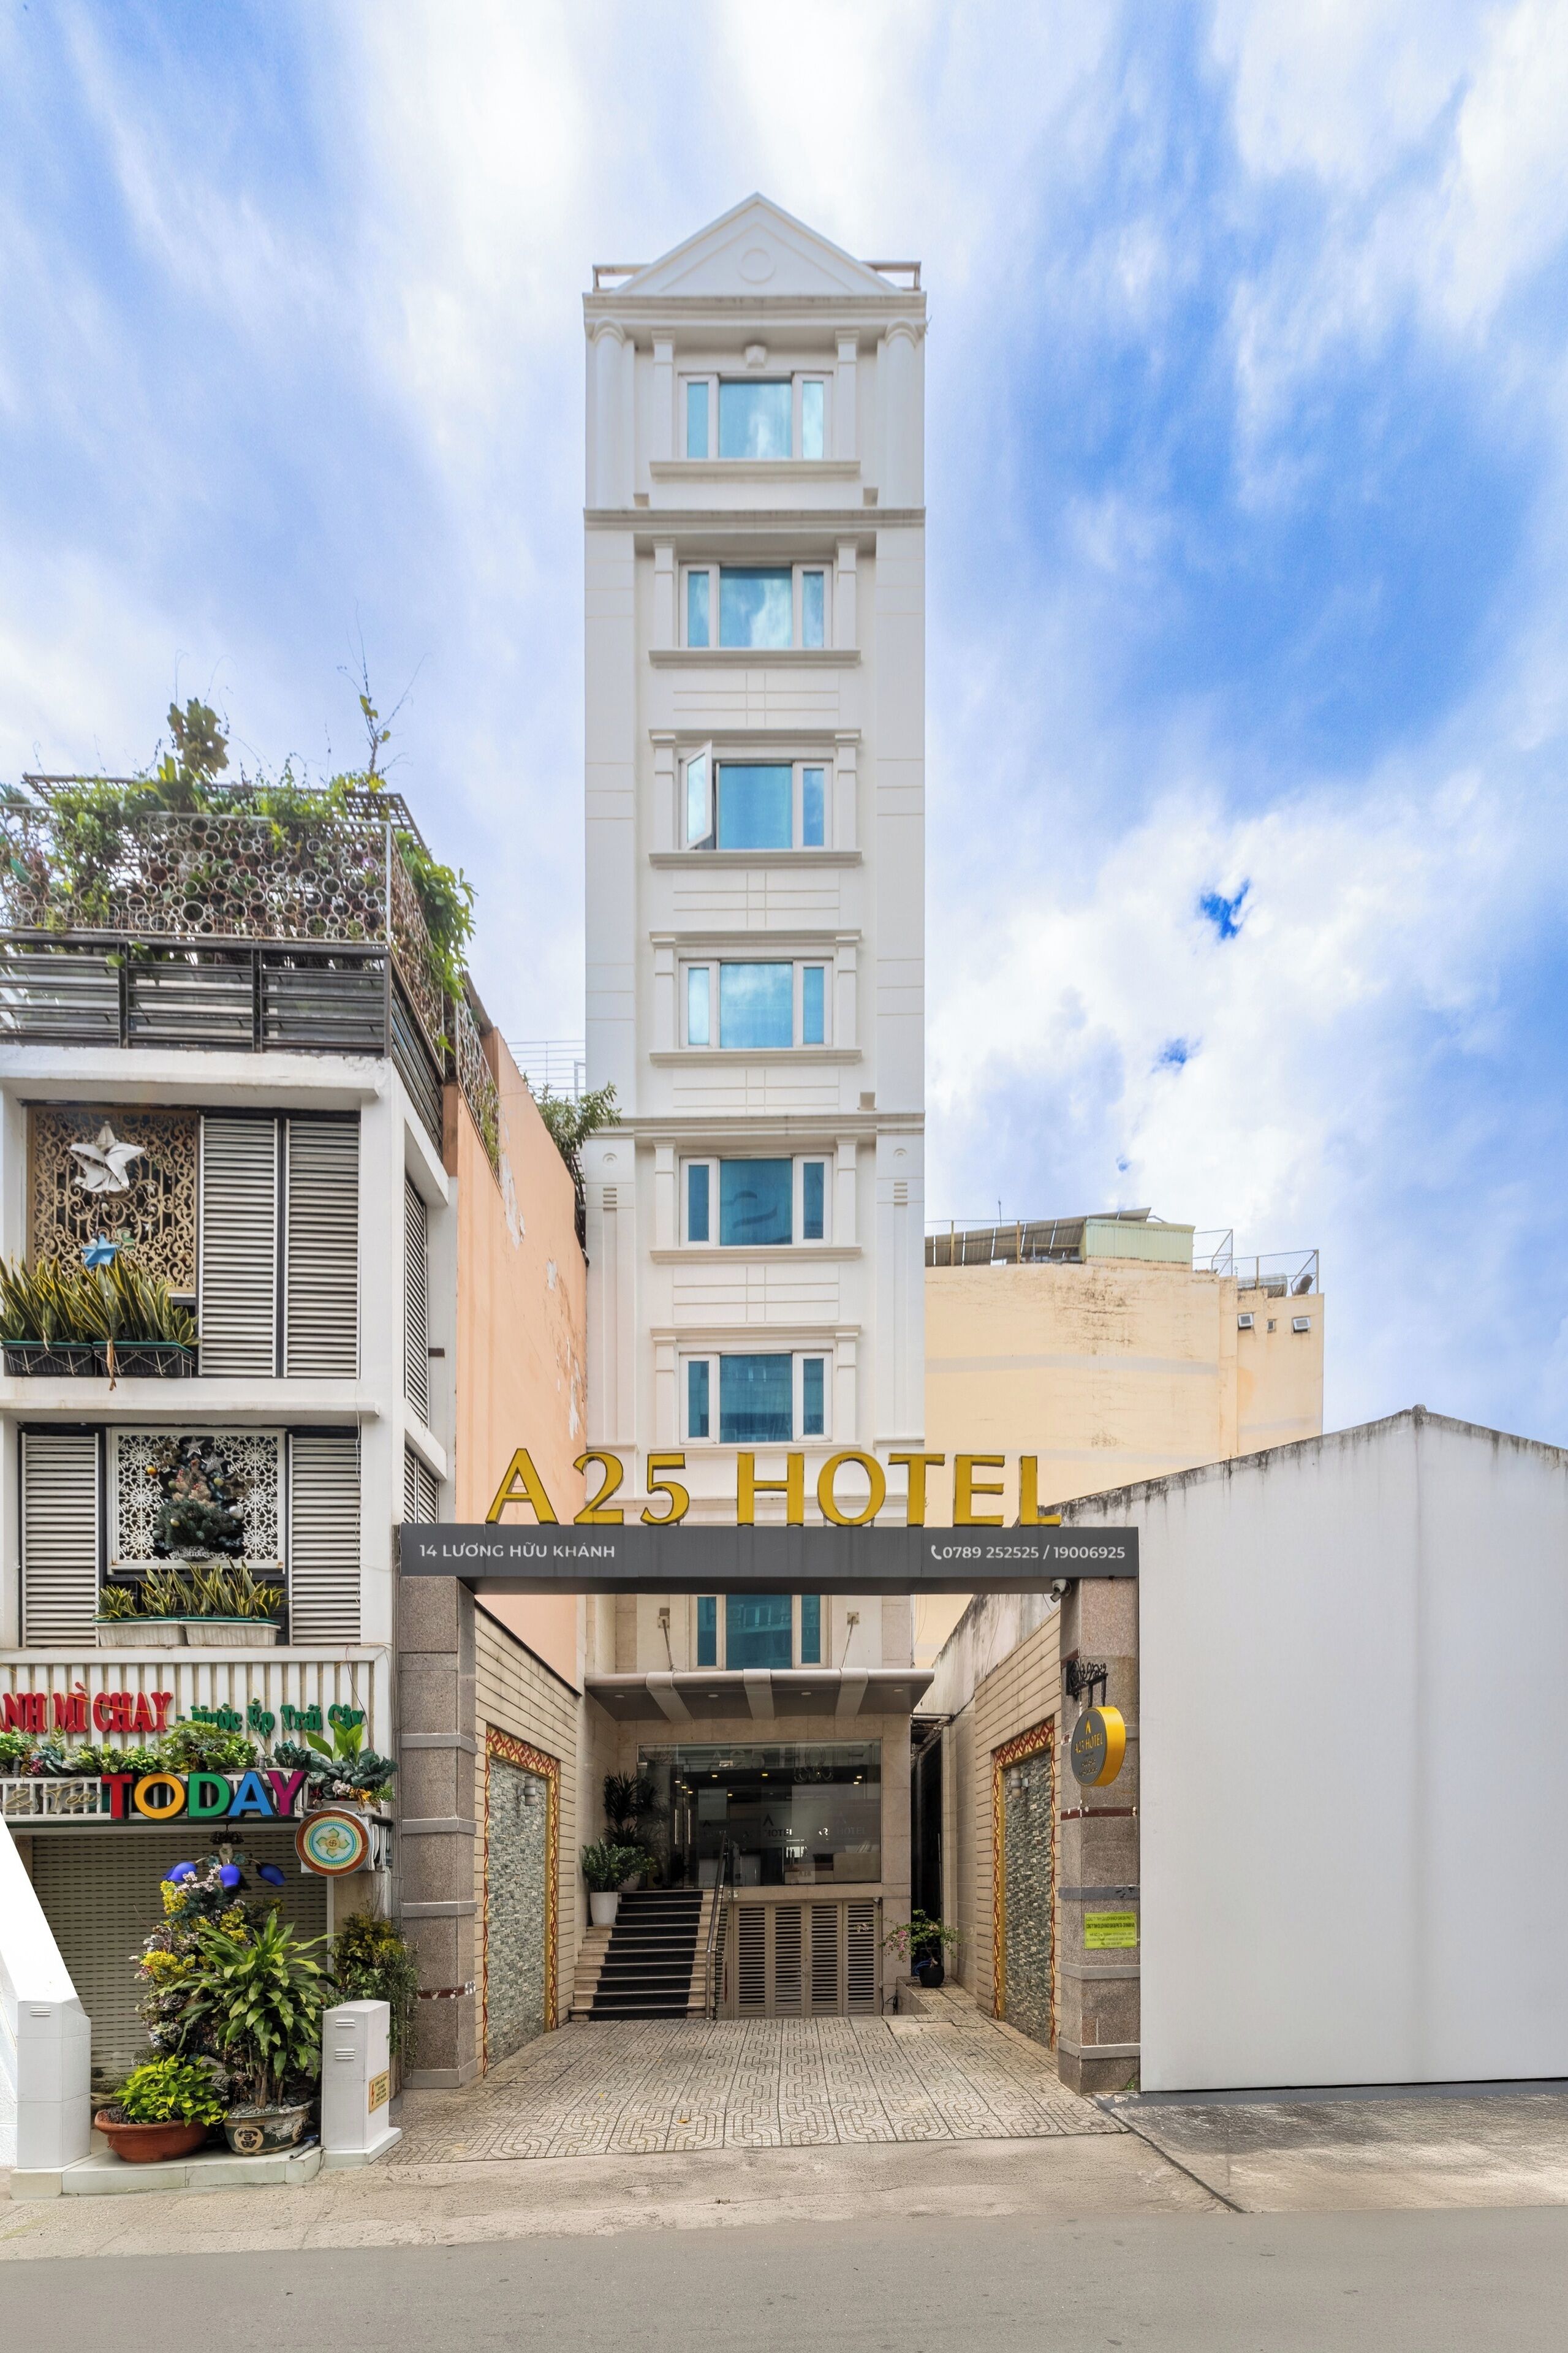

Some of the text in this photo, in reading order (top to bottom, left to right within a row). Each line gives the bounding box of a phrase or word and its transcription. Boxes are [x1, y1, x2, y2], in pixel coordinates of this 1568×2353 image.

[485, 1447, 1061, 1526] A25 HOTEL
[420, 1542, 615, 1558] 14 LƯƠNG HỮU KHÁNH
[942, 1544, 1126, 1559] 0789 252525 / 19006925
[0, 1692, 48, 1733] NH
[53, 1681, 89, 1733] MÌ
[93, 1691, 173, 1733] CHAY
[247, 1697, 275, 1737] Ép
[1085, 1732, 1104, 1751] HOTEL
[4, 1778, 96, 1809] & Tea
[100, 1770, 308, 1820] TODAY
